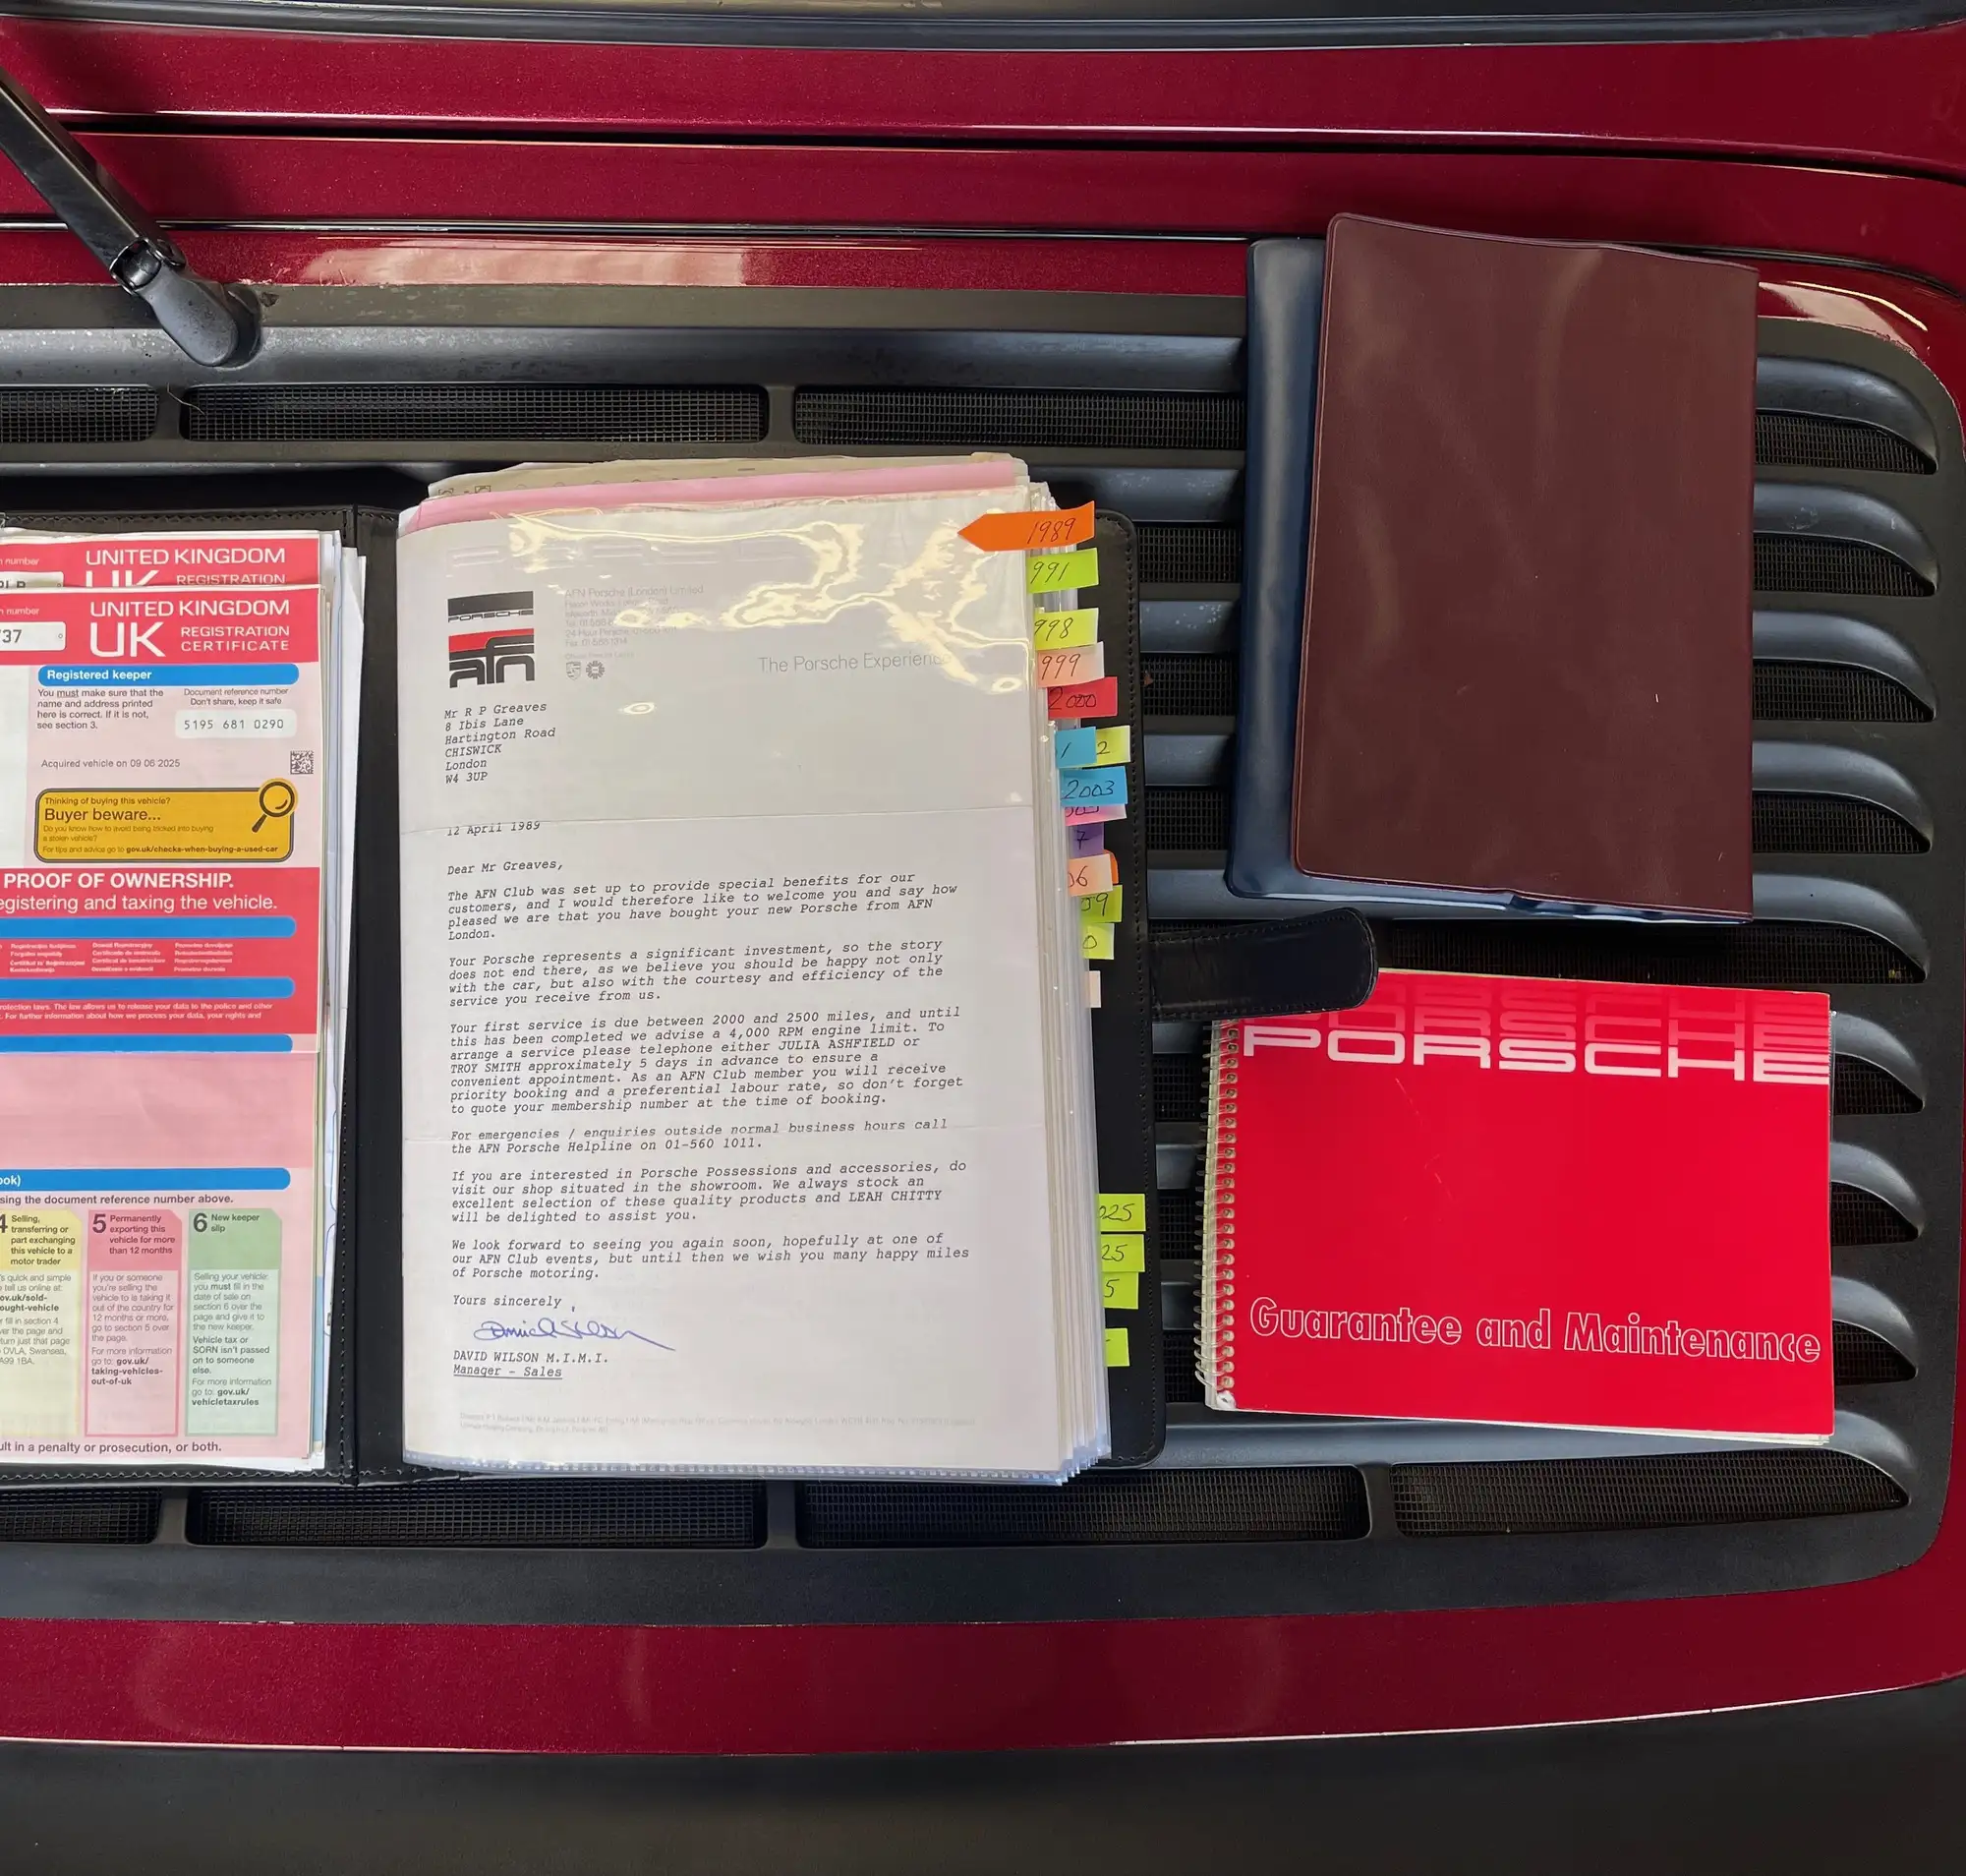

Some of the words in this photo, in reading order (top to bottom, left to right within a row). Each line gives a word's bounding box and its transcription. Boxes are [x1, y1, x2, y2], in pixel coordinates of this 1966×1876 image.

[1026, 517, 1076, 545] 1989
[5, 557, 39, 565] number
[87, 549, 169, 565] UNITED
[175, 548, 285, 564] KINGDOM
[6, 607, 39, 616] number
[90, 601, 174, 616] UNITED
[179, 600, 289, 616] KINGDOM
[447, 610, 534, 622] PORSCHE
[0, 629, 22, 643] 37
[181, 625, 289, 637] REGISTRATION
[89, 621, 166, 658] UK
[181, 640, 288, 652] CERTIFICATE
[758, 657, 788, 673] The
[793, 654, 858, 671] Porsche
[47, 670, 109, 681] Registered
[112, 670, 152, 681] keeper
[37, 688, 54, 697] You
[56, 689, 80, 698] must
[82, 688, 106, 697] make
[130, 688, 146, 697] that
[149, 688, 164, 697] the
[64, 699, 82, 708] and
[84, 699, 120, 708] address
[122, 700, 153, 710] printed
[190, 697, 211, 706] Don't
[37, 710, 57, 719] here
[59, 710, 67, 719] is
[105, 710, 112, 719] If
[122, 710, 130, 719] is
[132, 711, 148, 720] not,
[444, 709, 458, 719] Mr
[465, 707, 472, 717] R
[479, 706, 487, 715] P
[493, 703, 547, 714] Greaves
[89, 721, 98, 730] 3.
[184, 720, 213, 730] 5195
[223, 720, 244, 730] 681
[254, 719, 284, 730] 0290
[445, 722, 451, 732] 8
[459, 719, 487, 731] Ibis
[493, 718, 524, 728] Lane
[444, 732, 516, 745] Hartington
[524, 727, 555, 738] Road
[445, 743, 502, 758] CHISWICK
[41, 759, 81, 770] Acquired
[83, 759, 114, 768] vehicle
[130, 759, 142, 768] 09
[144, 759, 155, 768] 06
[157, 759, 181, 768] 2025
[445, 758, 487, 771] London
[445, 774, 459, 784] W4
[466, 771, 488, 782] 3UP
[1064, 779, 1115, 800] 2003
[44, 797, 79, 806] Thinking
[90, 796, 119, 806] buying
[45, 808, 88, 824] Buyer
[92, 807, 160, 821] beware...
[467, 822, 501, 837] April
[511, 820, 541, 831] 1989
[447, 865, 475, 875] Dear
[482, 862, 496, 872] Mr
[503, 860, 562, 871] Greaves,
[4, 873, 73, 888] PROOF
[78, 873, 105, 888] OF
[110, 872, 234, 888] OWNERSHIP.
[448, 891, 468, 902] The
[475, 889, 496, 899] AFN
[503, 886, 534, 898] Club
[573, 885, 597, 894] set
[606, 885, 621, 896] up
[629, 883, 645, 893] to
[653, 880, 710, 895] provide
[719, 877, 774, 892] special
[782, 875, 848, 887] benefits
[857, 874, 882, 884] for
[891, 874, 915, 883] our
[0, 895, 78, 914] egistering
[84, 895, 116, 909] and
[122, 895, 174, 913] taxing
[180, 895, 207, 909] the
[212, 895, 277, 909] vehicle.
[450, 1047, 498, 1062] arrange
[521, 1046, 575, 1058] service
[582, 1045, 631, 1059] please
[640, 1043, 713, 1056] telephone
[722, 1041, 771, 1052] either
[779, 1040, 820, 1050] JULIA
[828, 1037, 896, 1049] ASHFIELD
[1243, 1026, 1830, 1085] PORSCHE
[92, 1213, 106, 1233] 5
[110, 1214, 162, 1224] Permanently
[194, 1212, 207, 1233] 6
[232, 1213, 260, 1222] keeper
[210, 1224, 226, 1233] slip
[453, 1295, 487, 1306] Yours
[493, 1295, 562, 1309] sincerely
[1250, 1296, 1462, 1345] Guarantee
[1476, 1308, 1551, 1350] and
[1563, 1311, 1821, 1363] Maintenance
[453, 1350, 488, 1361] DAVID
[493, 1352, 539, 1363] WILSON
[546, 1353, 607, 1363] M.I.M.I.
[453, 1364, 502, 1379] Manager
[524, 1366, 561, 1377] Sales
[15, 1441, 25, 1451] in
[38, 1441, 81, 1454] penalty
[99, 1442, 172, 1454] prosecution,
[192, 1441, 221, 1451] both.
